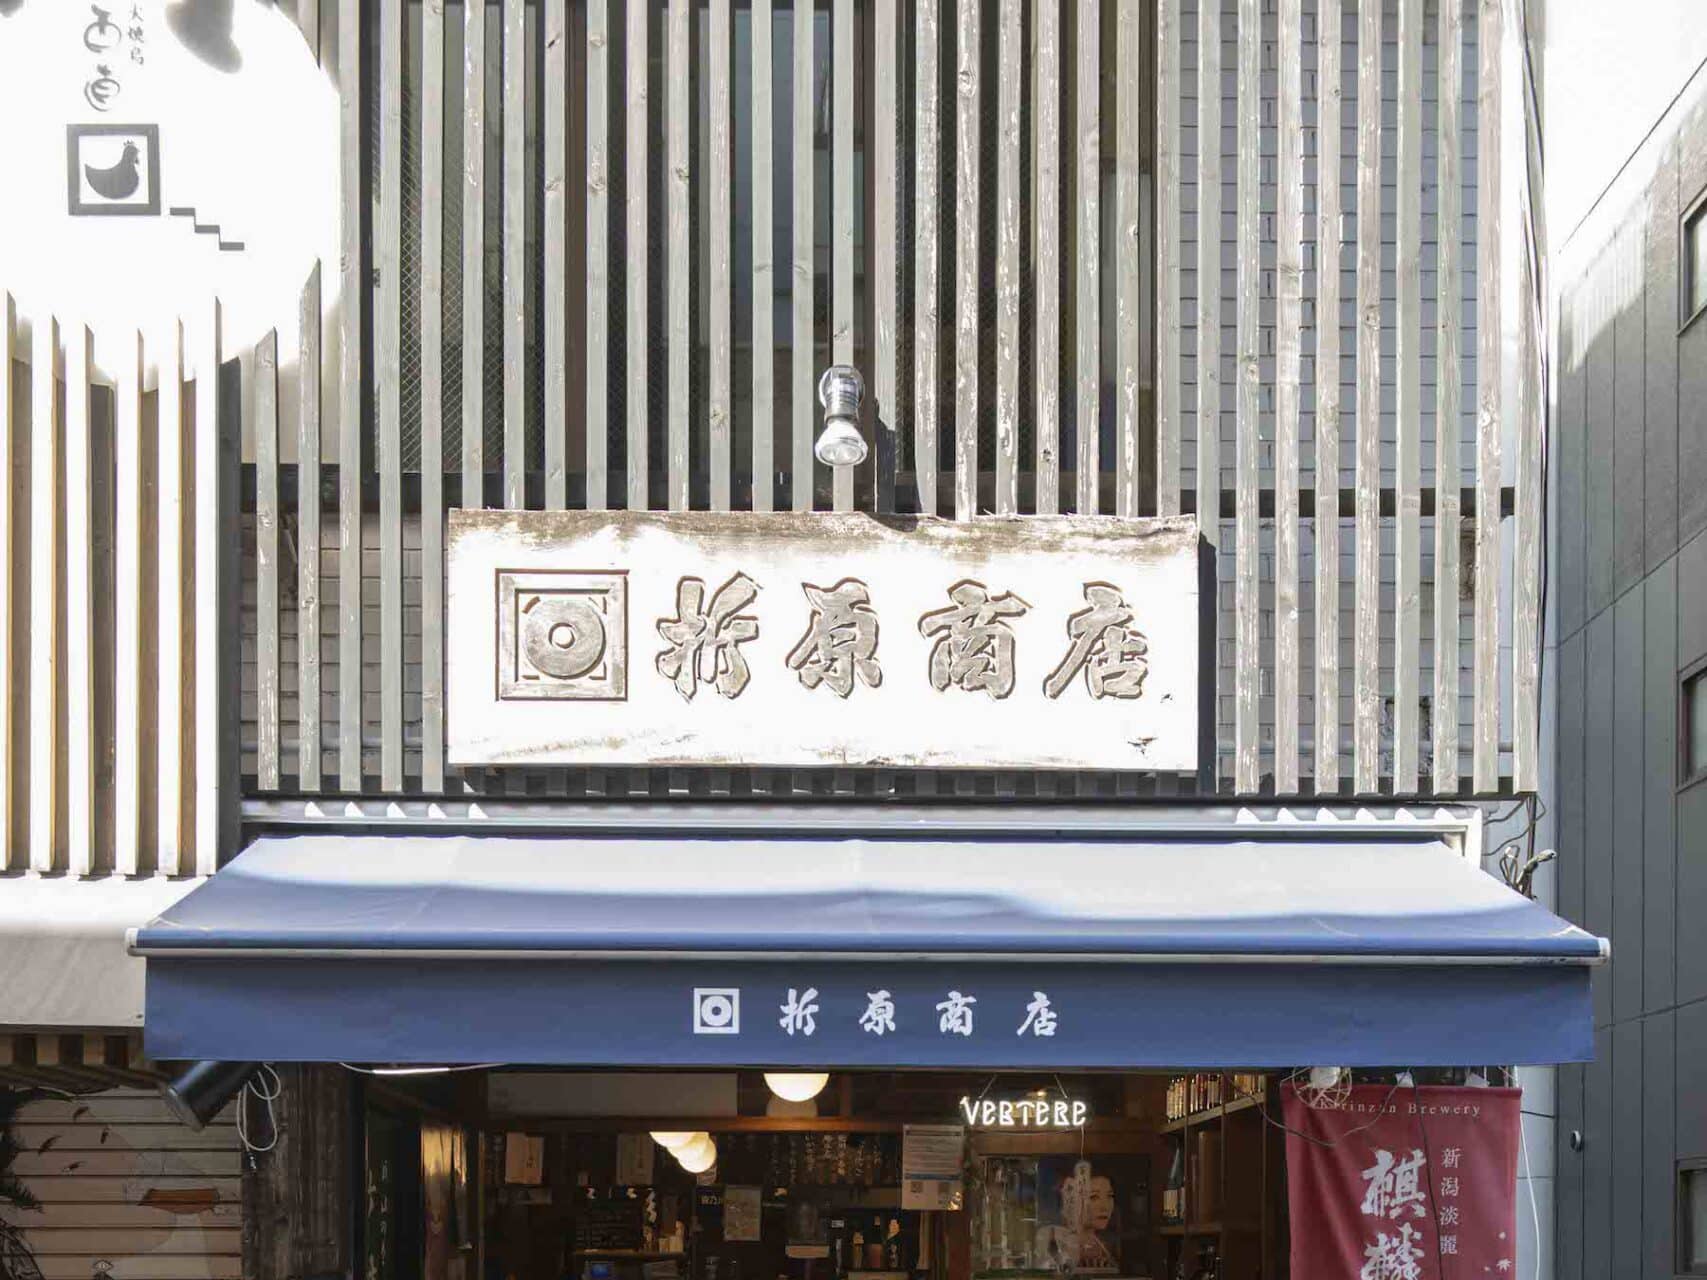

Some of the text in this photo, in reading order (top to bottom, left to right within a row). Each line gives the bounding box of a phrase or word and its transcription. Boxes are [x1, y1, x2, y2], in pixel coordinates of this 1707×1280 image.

[655, 570, 1152, 702] 折原商店
[779, 986, 1060, 1037] 折原商店
[1408, 1103, 1481, 1118] Brewery
[1438, 1147, 1464, 1256] 新潟淡麗
